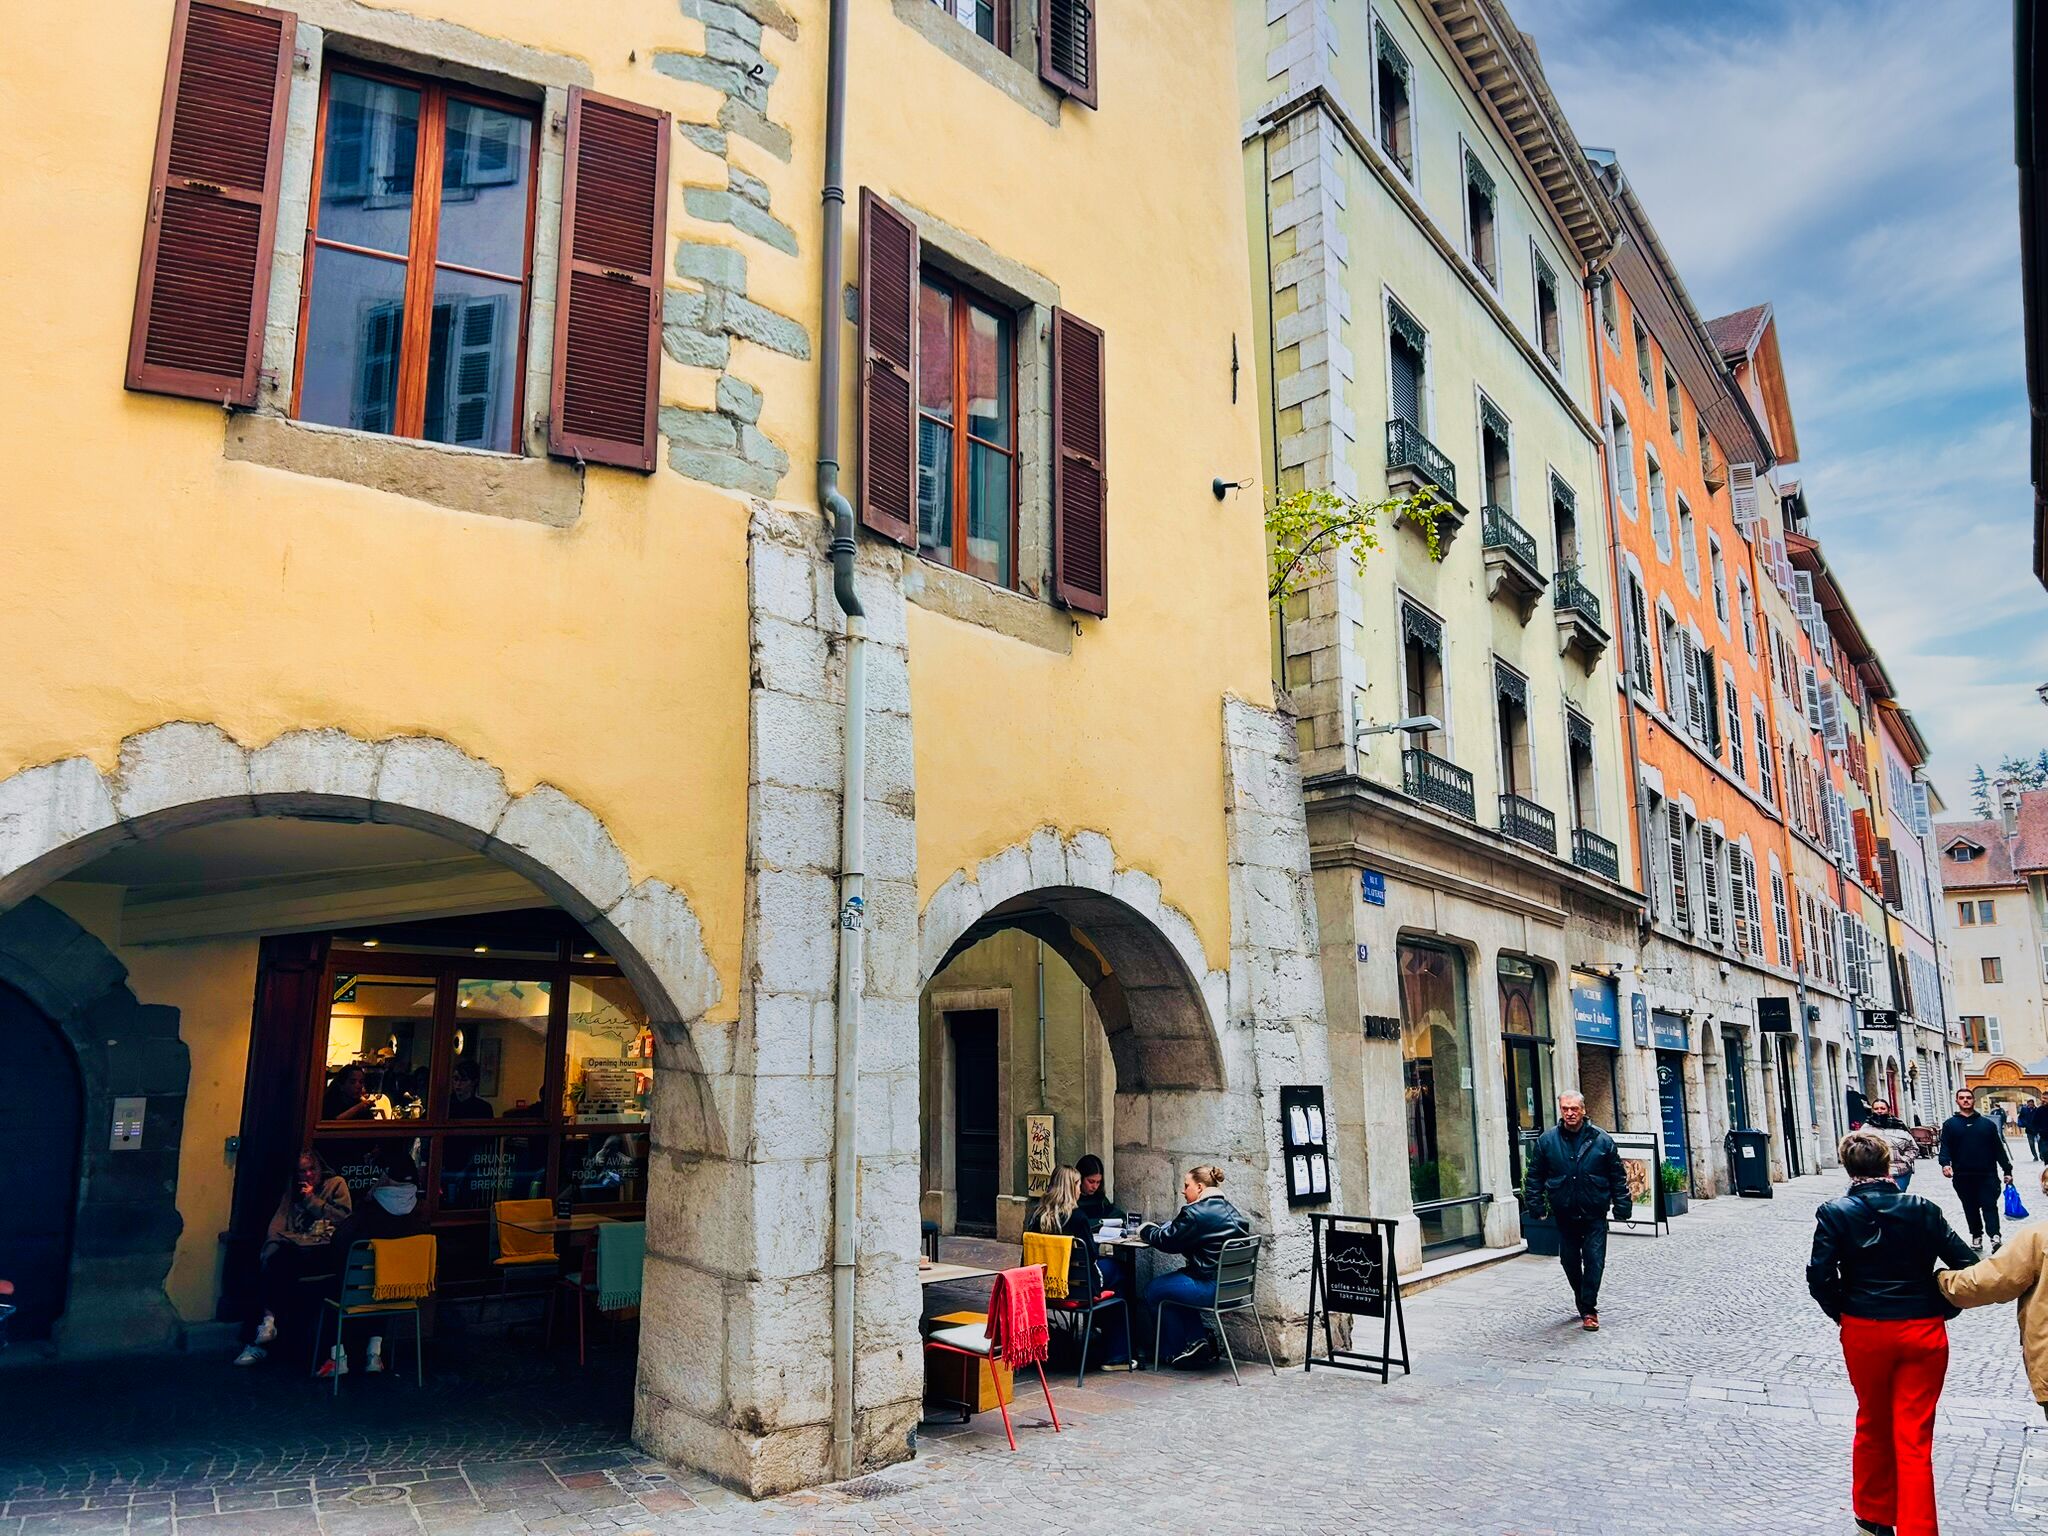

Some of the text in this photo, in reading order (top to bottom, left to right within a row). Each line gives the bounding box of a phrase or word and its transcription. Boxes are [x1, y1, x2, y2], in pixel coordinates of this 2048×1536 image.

[1360, 946, 1366, 959] 9
[588, 1058, 638, 1068] Opening hours
[473, 1153, 516, 1165] BRUNCH
[477, 1166, 511, 1177] LUNCH
[571, 1169, 597, 1181] FOOD
[348, 1178, 376, 1190] COFF
[470, 1178, 513, 1191] BREKKIE
[1357, 1285, 1380, 1294] kitchen
[1355, 1295, 1372, 1303] away
